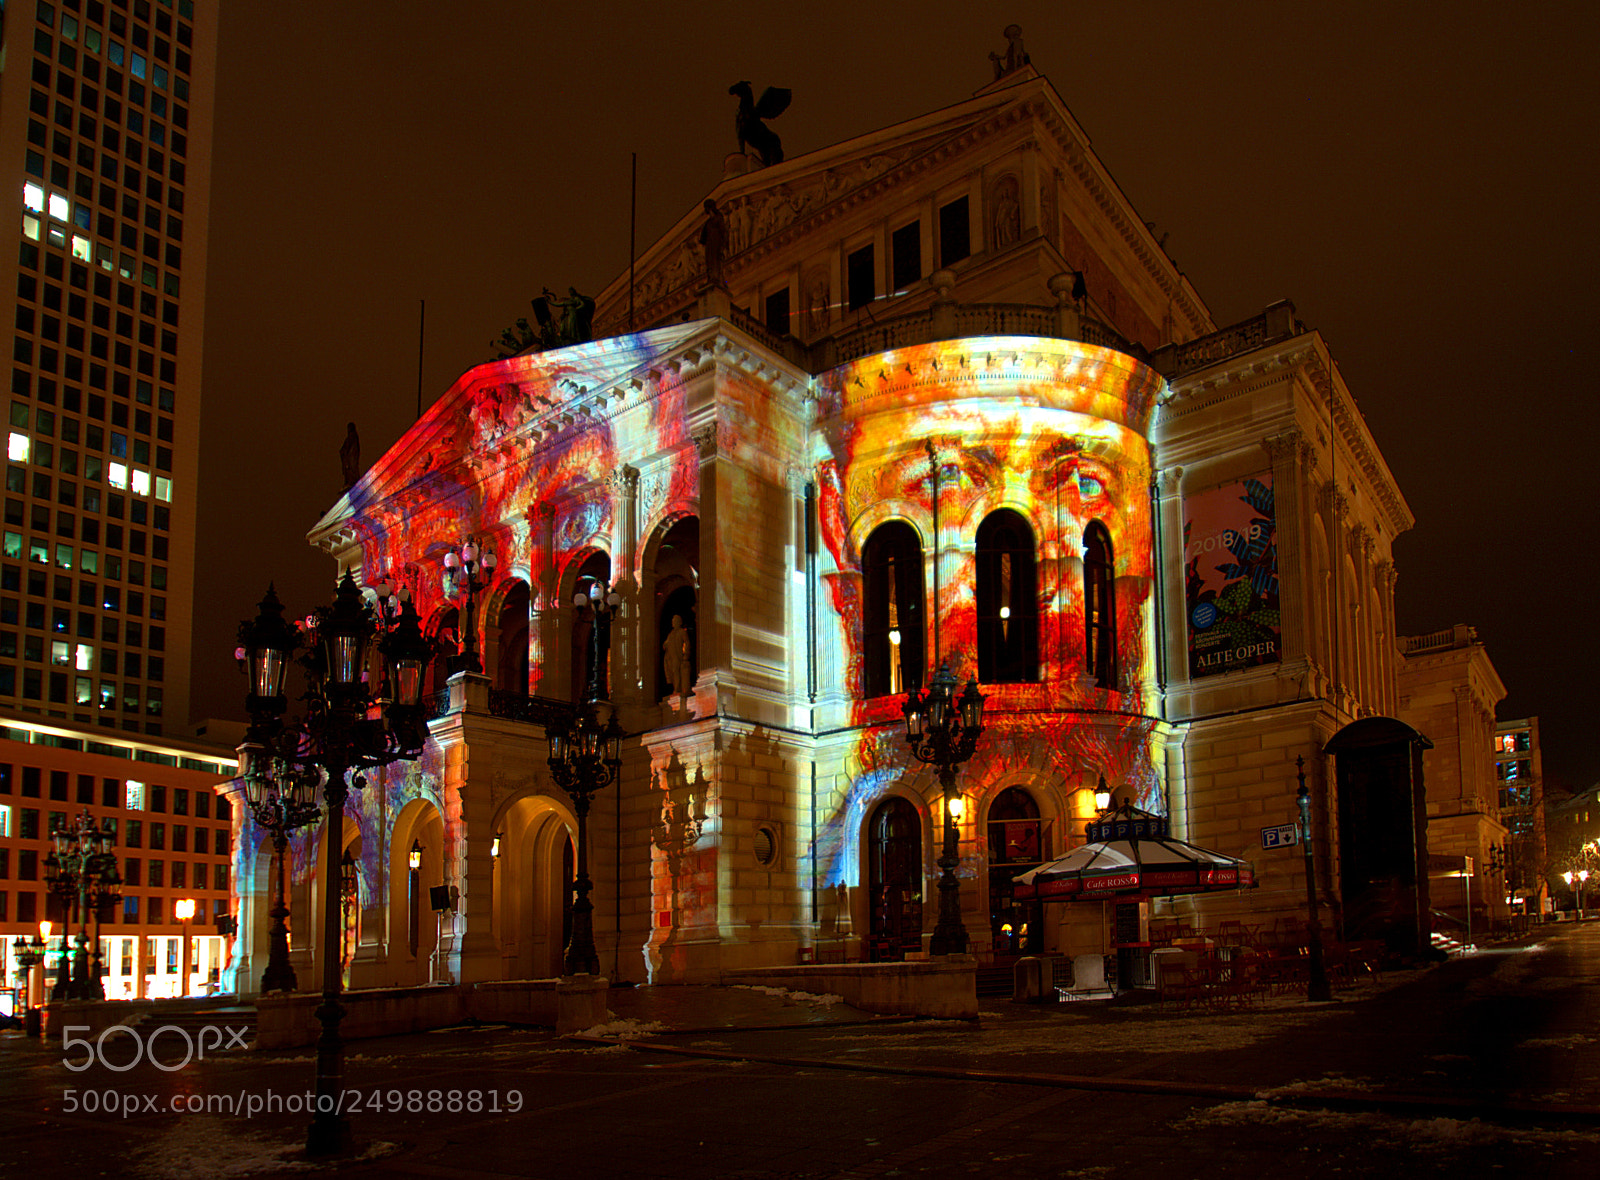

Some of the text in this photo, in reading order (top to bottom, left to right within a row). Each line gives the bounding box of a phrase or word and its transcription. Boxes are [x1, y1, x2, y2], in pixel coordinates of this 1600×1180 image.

[1192, 524, 1261, 556] 2018/19
[1196, 649, 1233, 668] ALTE
[1236, 641, 1276, 660] OPER
[1118, 827, 1127, 837] P
[1135, 825, 1144, 836] P
[1266, 833, 1276, 846] P
[1107, 876, 1138, 887] ROSSO
